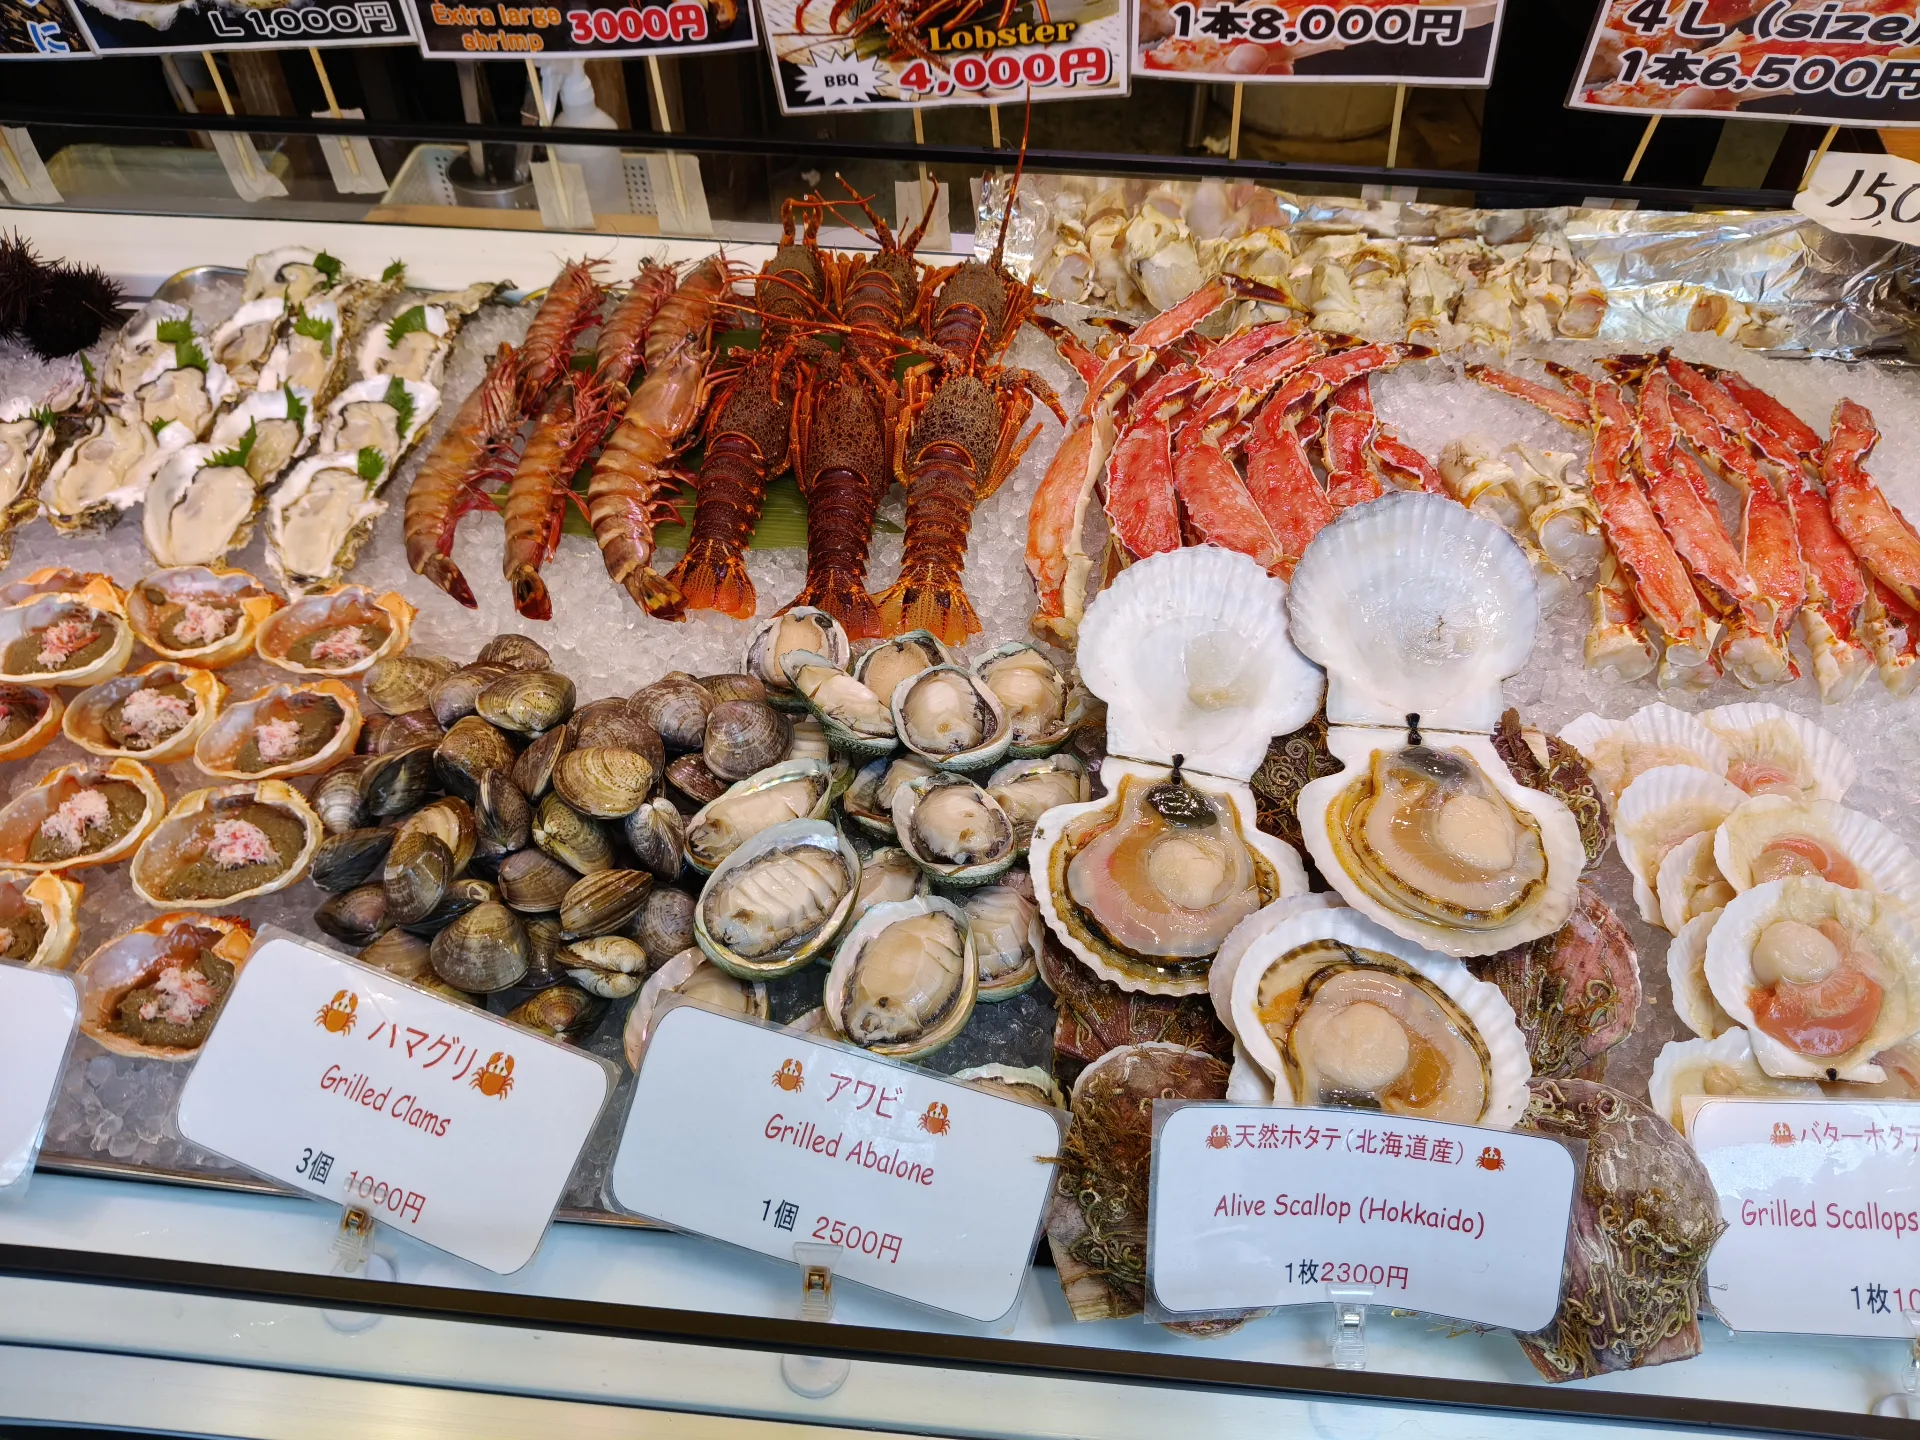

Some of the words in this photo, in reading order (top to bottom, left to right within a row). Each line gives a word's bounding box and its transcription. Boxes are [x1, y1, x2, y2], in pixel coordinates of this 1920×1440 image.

[24, 0, 70, 53] に
[208, 11, 245, 37] L
[245, 1, 397, 38] 1,000円
[431, 4, 496, 26] Extra
[497, 3, 561, 28] large
[567, 4, 709, 43] 3000円
[928, 21, 1076, 51] Lobster
[1172, 5, 1465, 44] 1本8,000円
[461, 29, 544, 53] shrimp
[824, 73, 860, 88] BBQ
[900, 47, 1113, 95] 4,000円
[1619, 50, 1920, 99] 1本6,500円
[368, 1020, 478, 1081] ハマグリ
[320, 1064, 392, 1113] Grilled
[391, 1093, 452, 1137] Clams
[826, 1073, 903, 1119] アワビ
[765, 1113, 842, 1158] Grilled
[845, 1140, 935, 1186] Abalone
[295, 1147, 335, 1185] 3個
[347, 1170, 427, 1224] 1000円
[761, 1199, 799, 1232] 1個
[812, 1216, 903, 1264] 2500円
[1214, 1192, 1266, 1218] Alive
[1273, 1192, 1351, 1223] Scallop
[1359, 1196, 1485, 1239] (Hokkaido)
[1741, 1199, 1817, 1228] Grilled
[1826, 1202, 1919, 1239] Scallops
